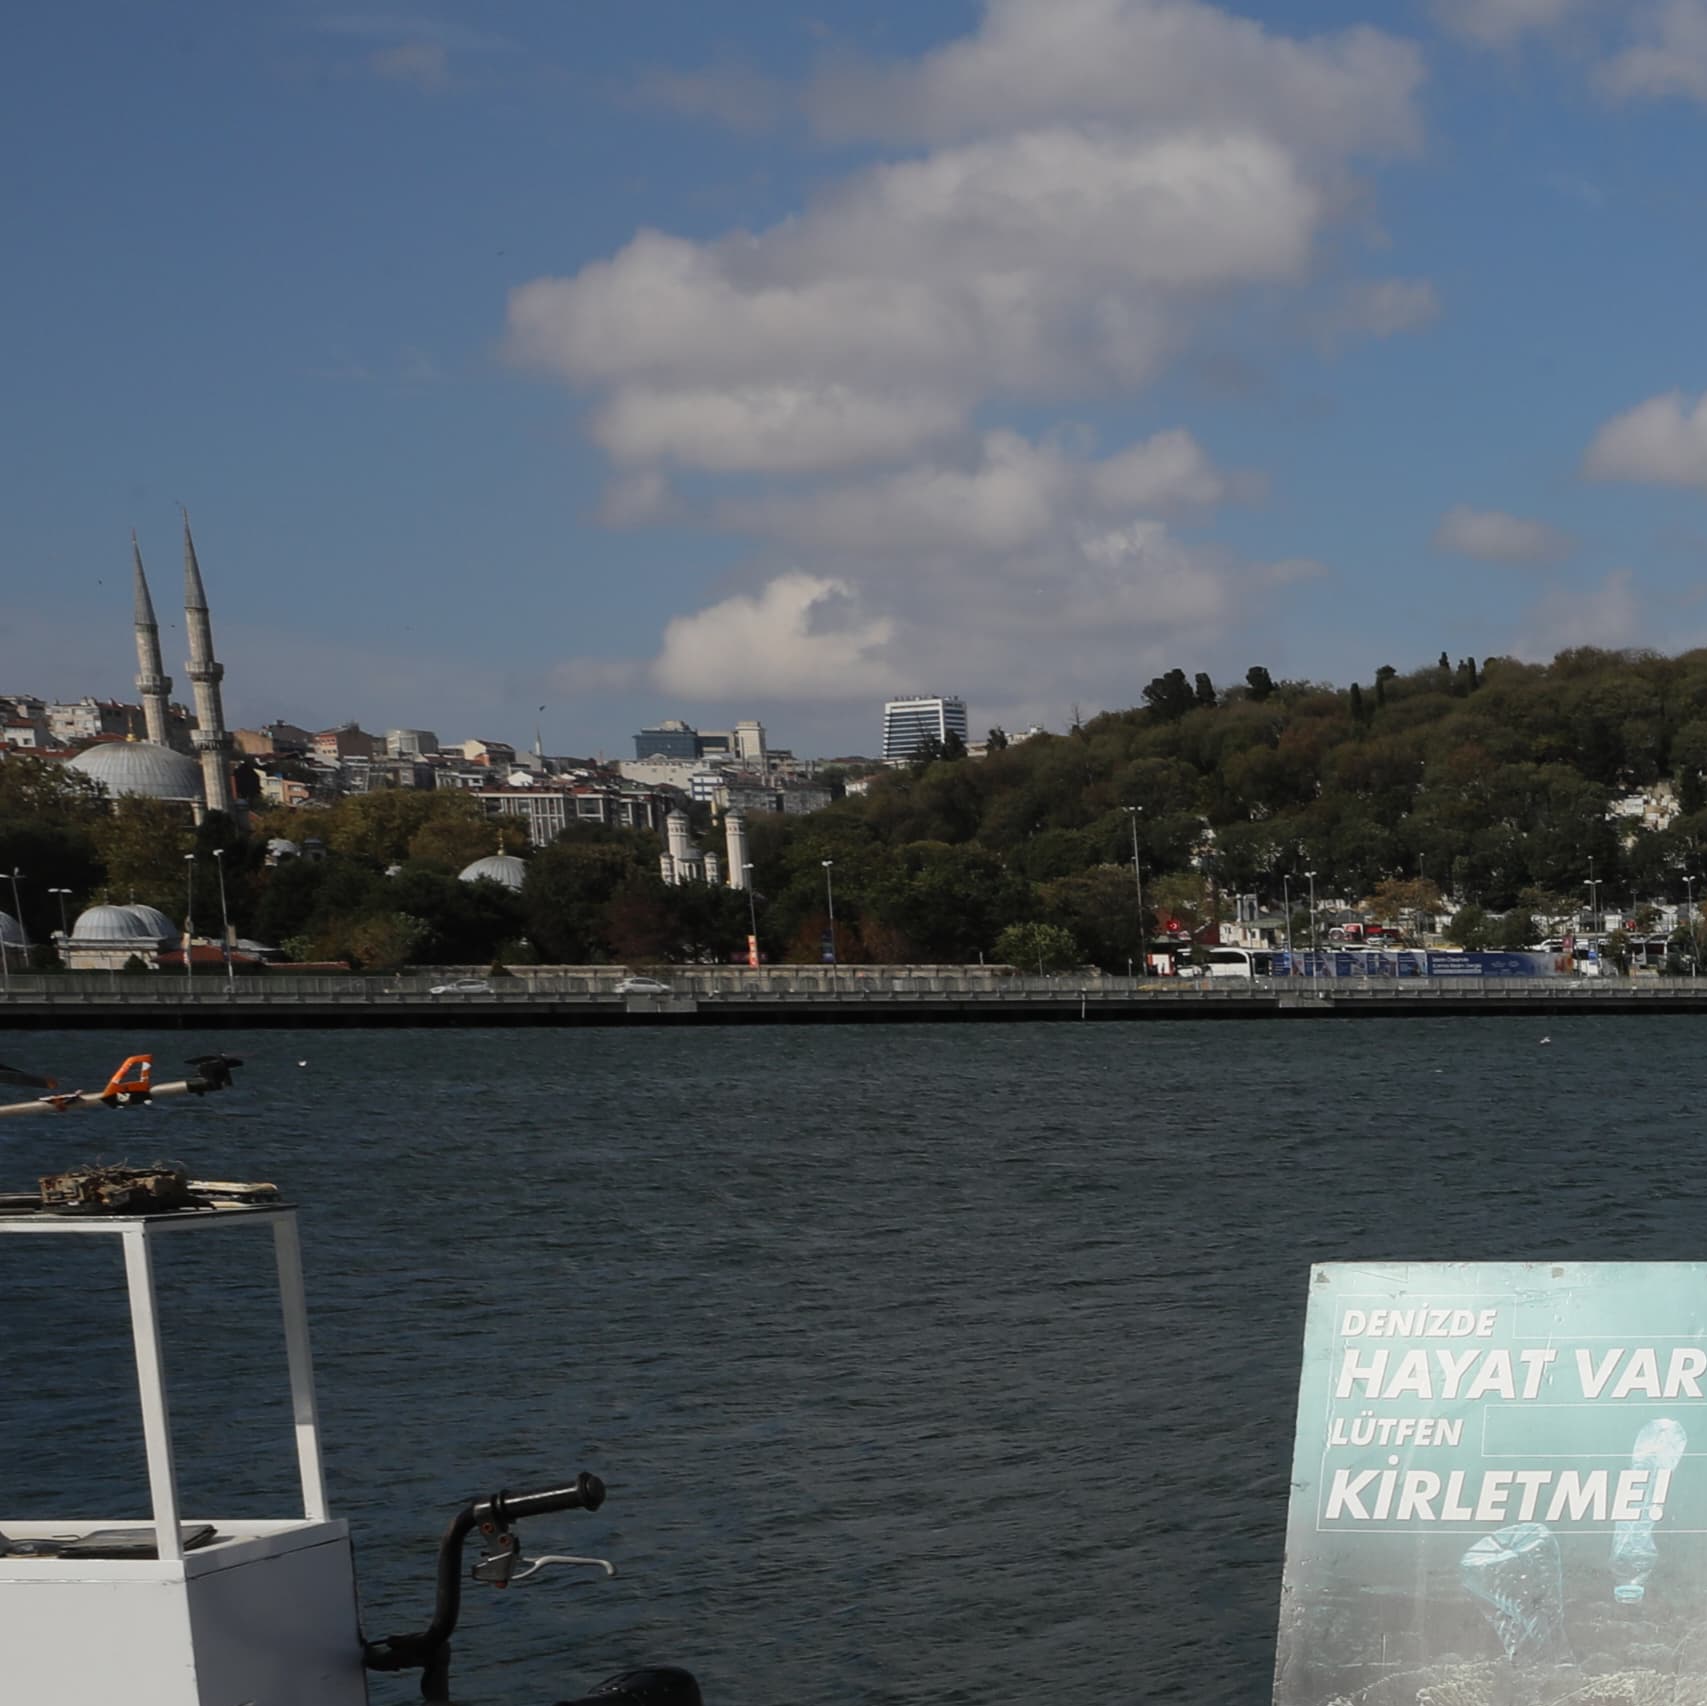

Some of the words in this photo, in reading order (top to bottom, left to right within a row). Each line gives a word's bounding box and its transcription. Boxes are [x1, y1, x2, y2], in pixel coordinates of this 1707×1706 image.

[1340, 1302, 1497, 1338] DENİZDE
[1334, 1347, 1557, 1400] HAYAT
[1331, 1411, 1463, 1447] LÜTFEN
[1324, 1454, 1671, 1522] KİRLETME!
